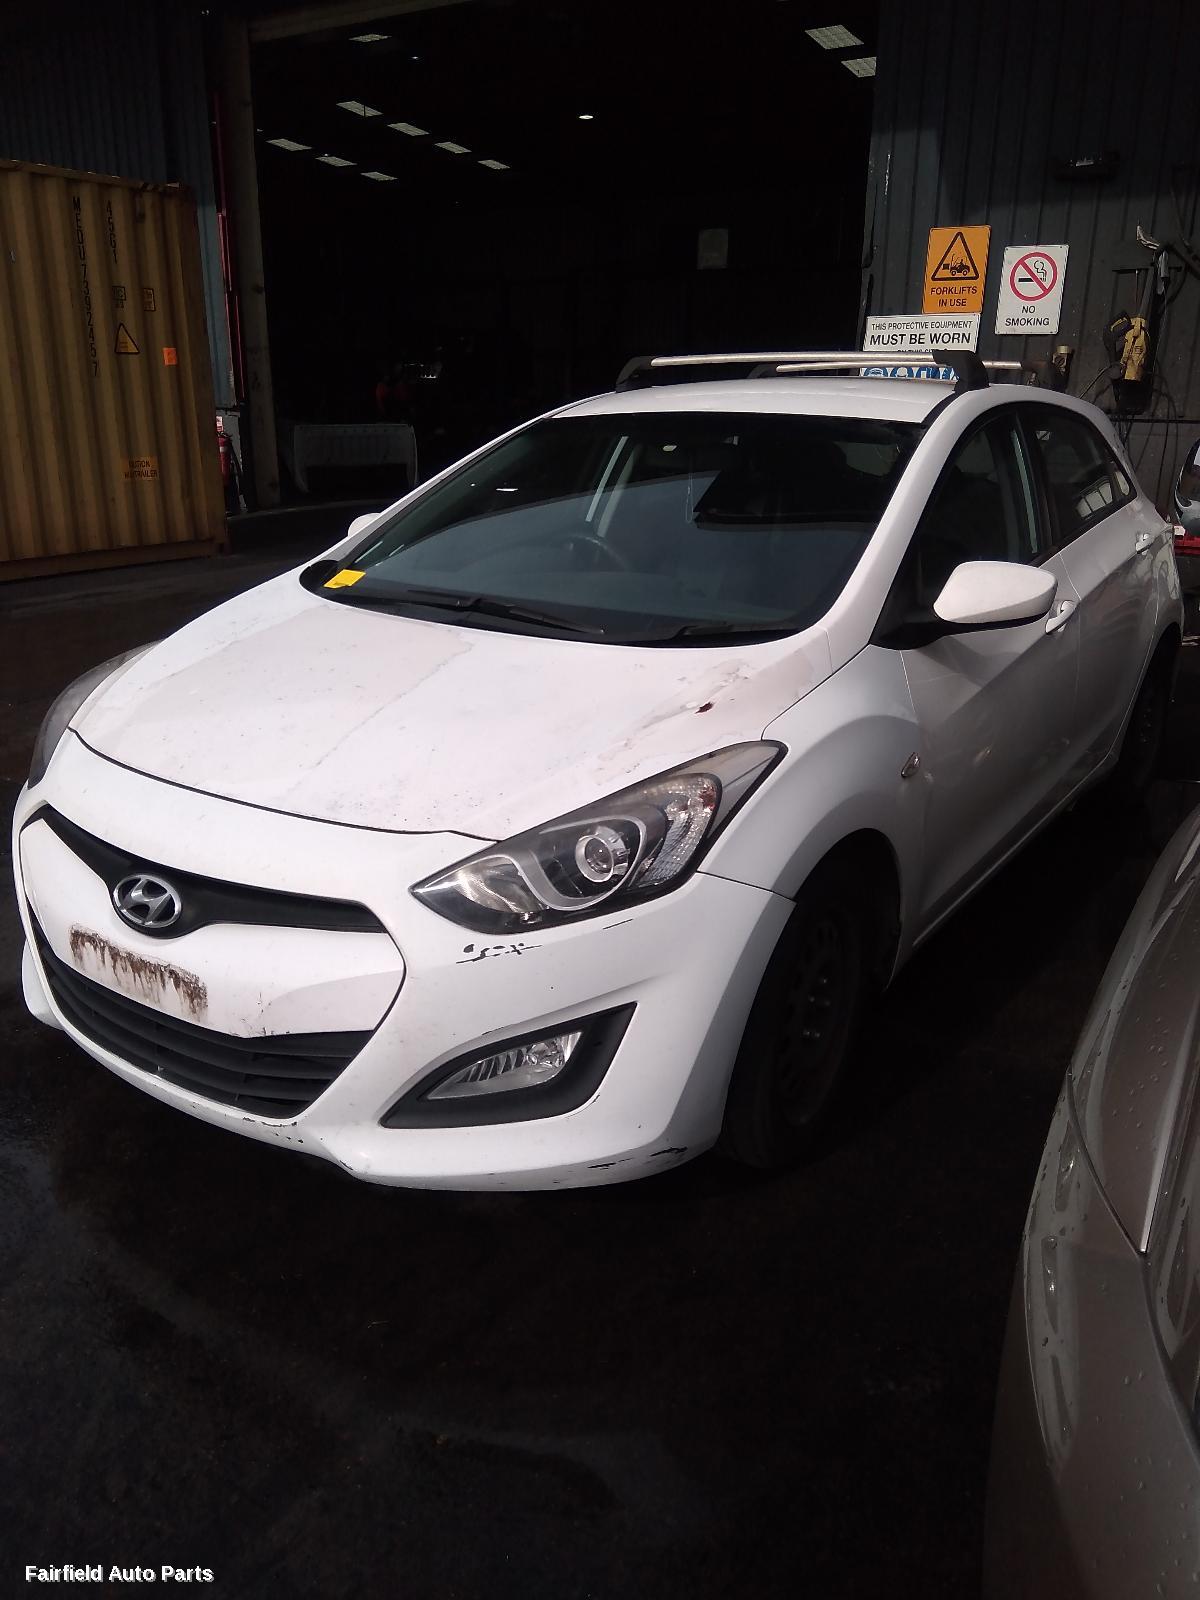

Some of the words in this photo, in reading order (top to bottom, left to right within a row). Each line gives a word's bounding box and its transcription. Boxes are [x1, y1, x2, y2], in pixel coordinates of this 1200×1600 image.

[930, 286, 978, 295] FORKLIFTS
[938, 299, 949, 307] IN
[949, 298, 967, 307] USE
[1021, 305, 1036, 314] NO
[871, 323, 887, 331] THIS
[888, 321, 929, 330] PROTECTIVE
[930, 320, 973, 329] EQUIPMENT
[1005, 317, 1050, 327] SMOKING
[869, 334, 906, 346] MUST
[909, 333, 925, 345] BE
[930, 332, 971, 344] WORN
